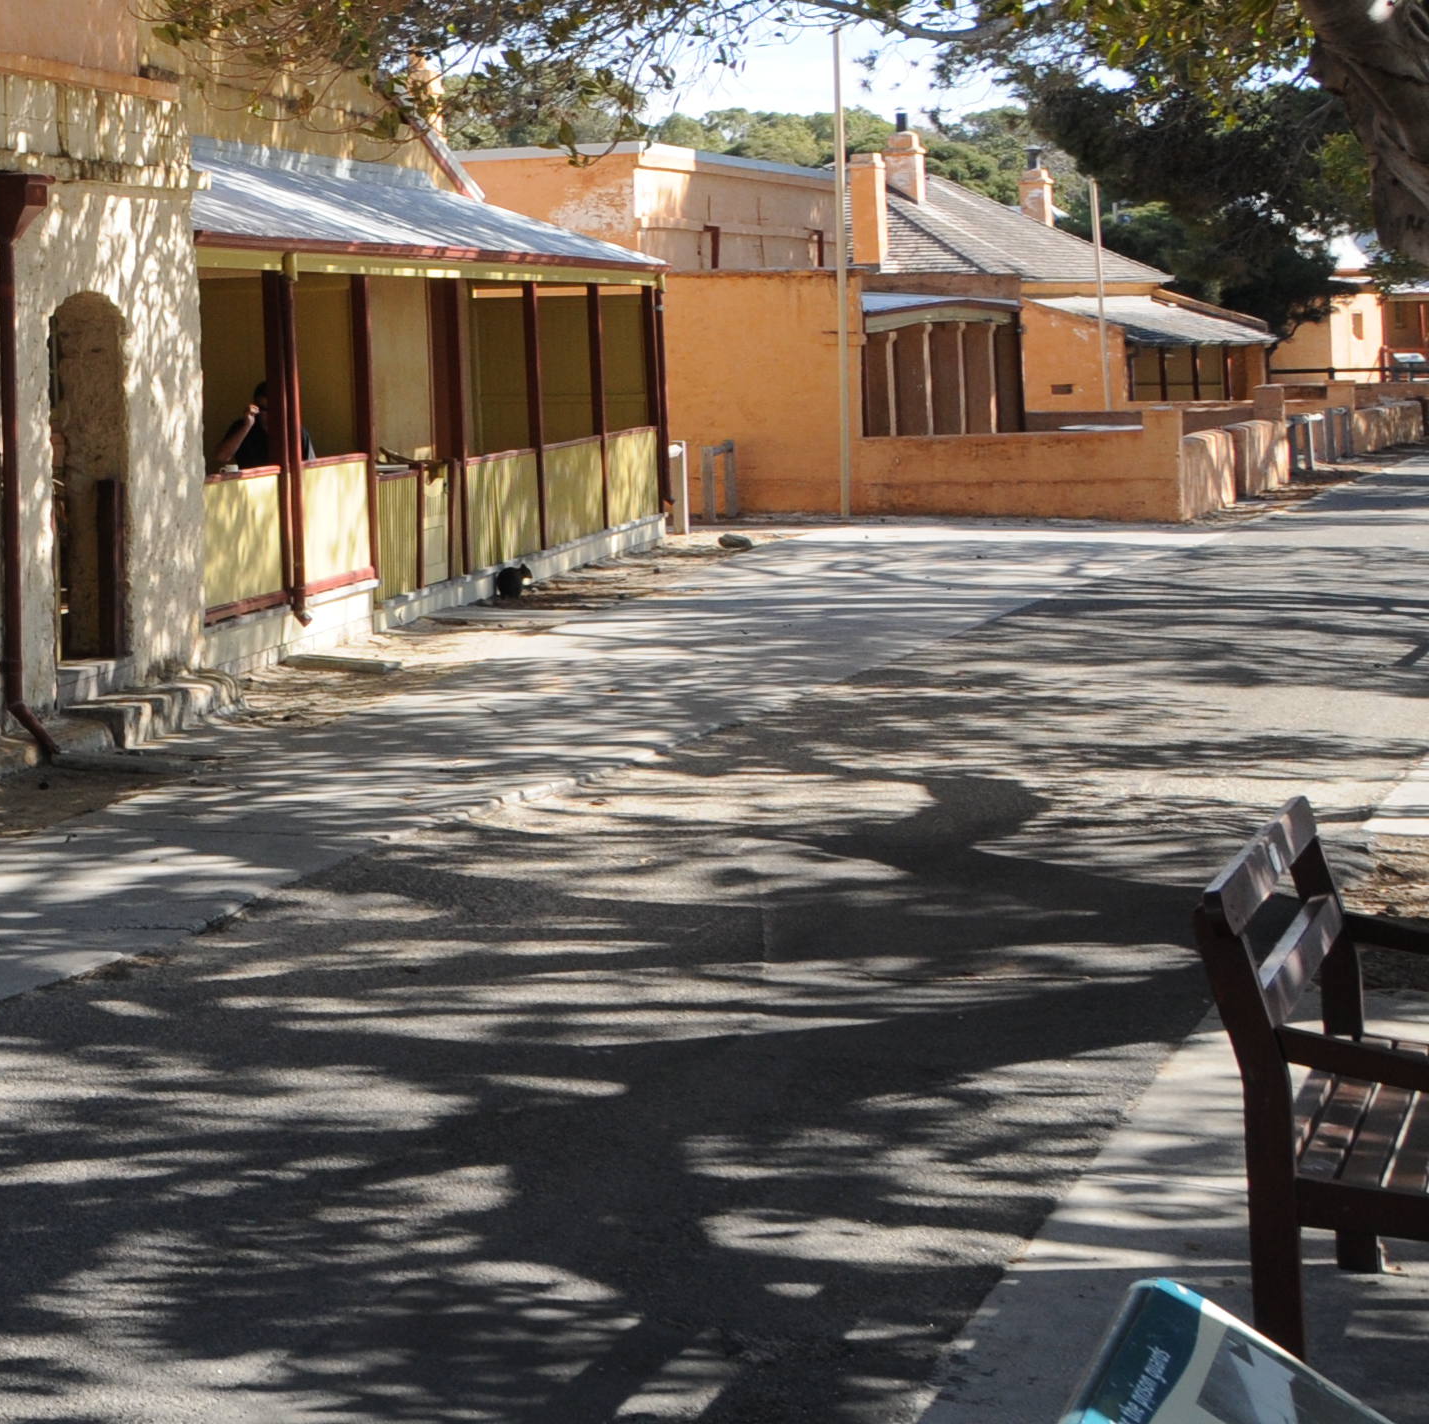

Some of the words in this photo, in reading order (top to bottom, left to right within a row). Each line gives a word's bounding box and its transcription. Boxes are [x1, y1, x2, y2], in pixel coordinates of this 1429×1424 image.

[1145, 1345, 1171, 1383] guards
[1129, 1374, 1158, 1411] prison
[1118, 1401, 1144, 1423] the
